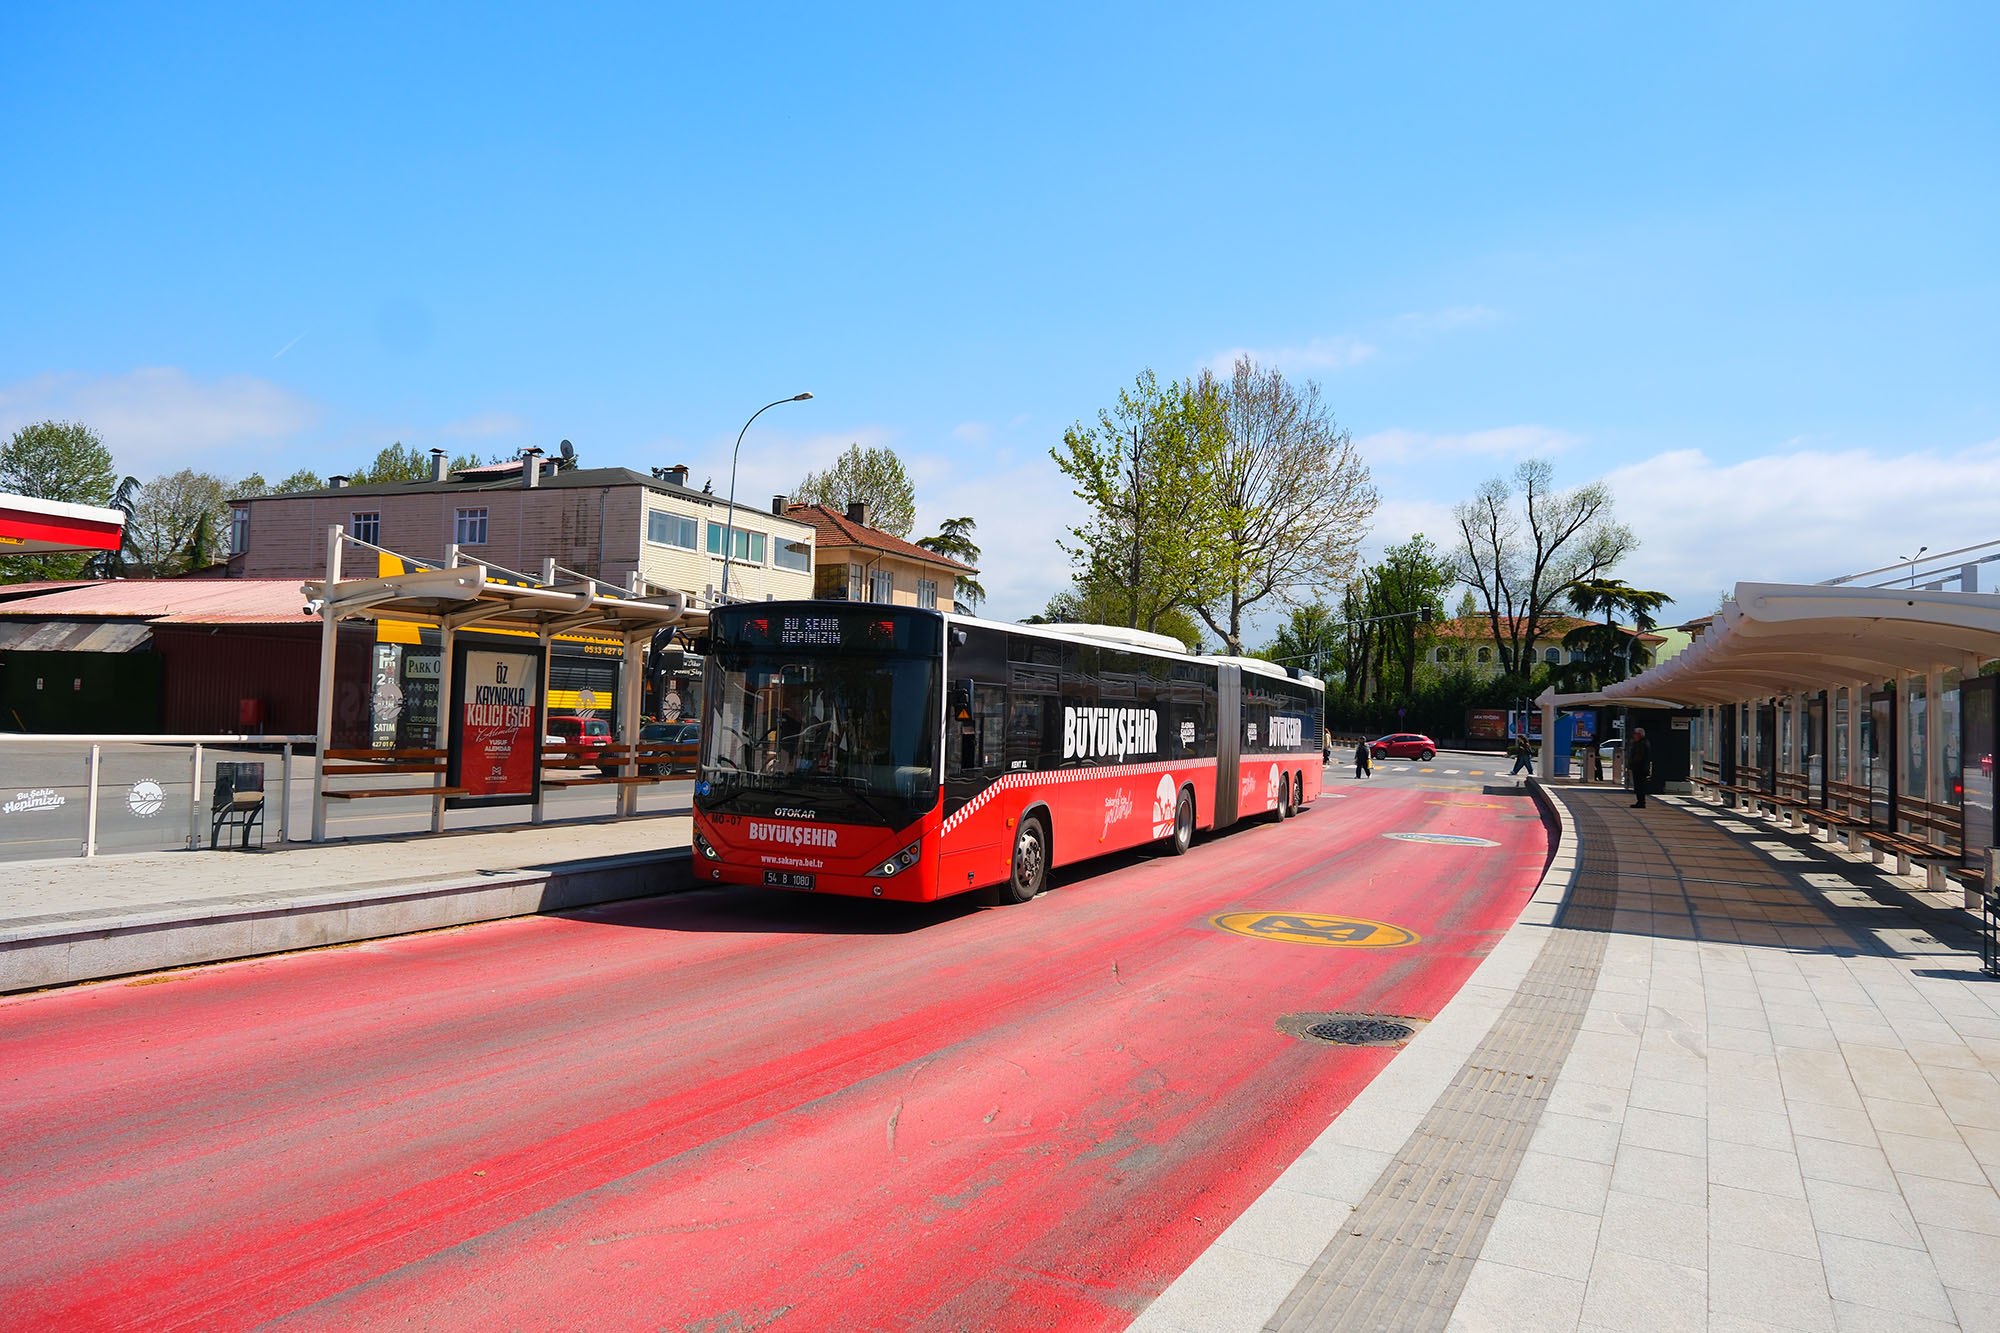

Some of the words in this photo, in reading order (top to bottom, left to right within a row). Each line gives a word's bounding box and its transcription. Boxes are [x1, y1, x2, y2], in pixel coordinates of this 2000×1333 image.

[584, 645, 602, 655] 0533
[603, 646, 617, 656] 427
[407, 659, 432, 674] PARK
[495, 661, 509, 685] ÖZ
[475, 685, 525, 706] KAYNAKLA
[466, 704, 503, 726] KALICI
[504, 706, 531, 728] ESER
[373, 723, 396, 733] SATIM
[1063, 705, 1159, 764] BÜYÜKŞEHİR
[16, 792, 29, 801] Bu
[774, 807, 816, 819] OTOKAR
[749, 822, 838, 848] BÜYÜKŞEHİR
[760, 855, 824, 869] www.sakarya.bel.tr
[767, 872, 778, 884] 54
[782, 874, 788, 885] B
[792, 875, 810, 887] 1080
